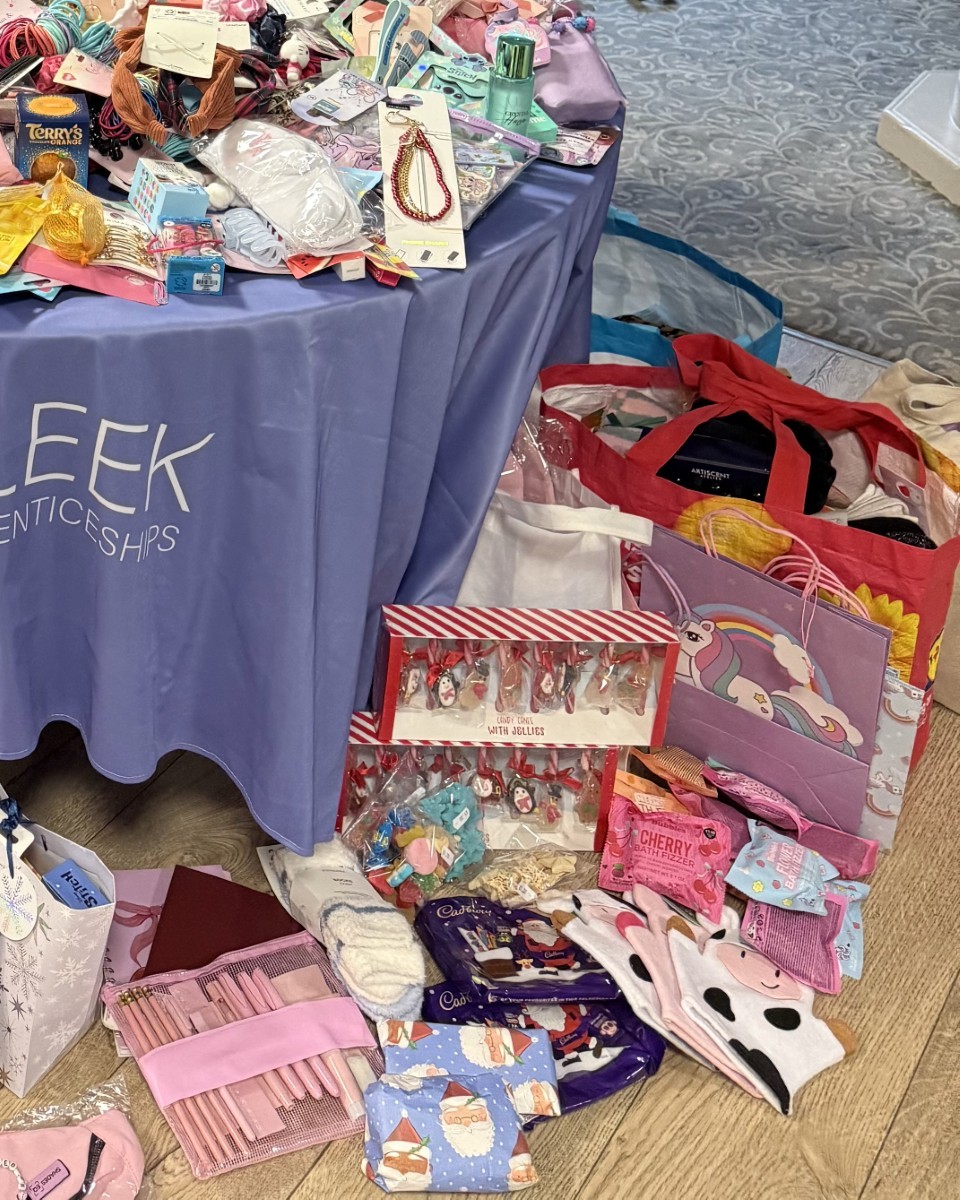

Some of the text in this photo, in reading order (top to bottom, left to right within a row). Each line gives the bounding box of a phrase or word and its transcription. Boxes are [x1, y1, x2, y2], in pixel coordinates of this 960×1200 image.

[488, 726, 545, 736] WITH JELLIES
[640, 829, 693, 858] CHERRY
[634, 843, 696, 869] BATH FIZZER
[436, 898, 493, 919] Cadbury
